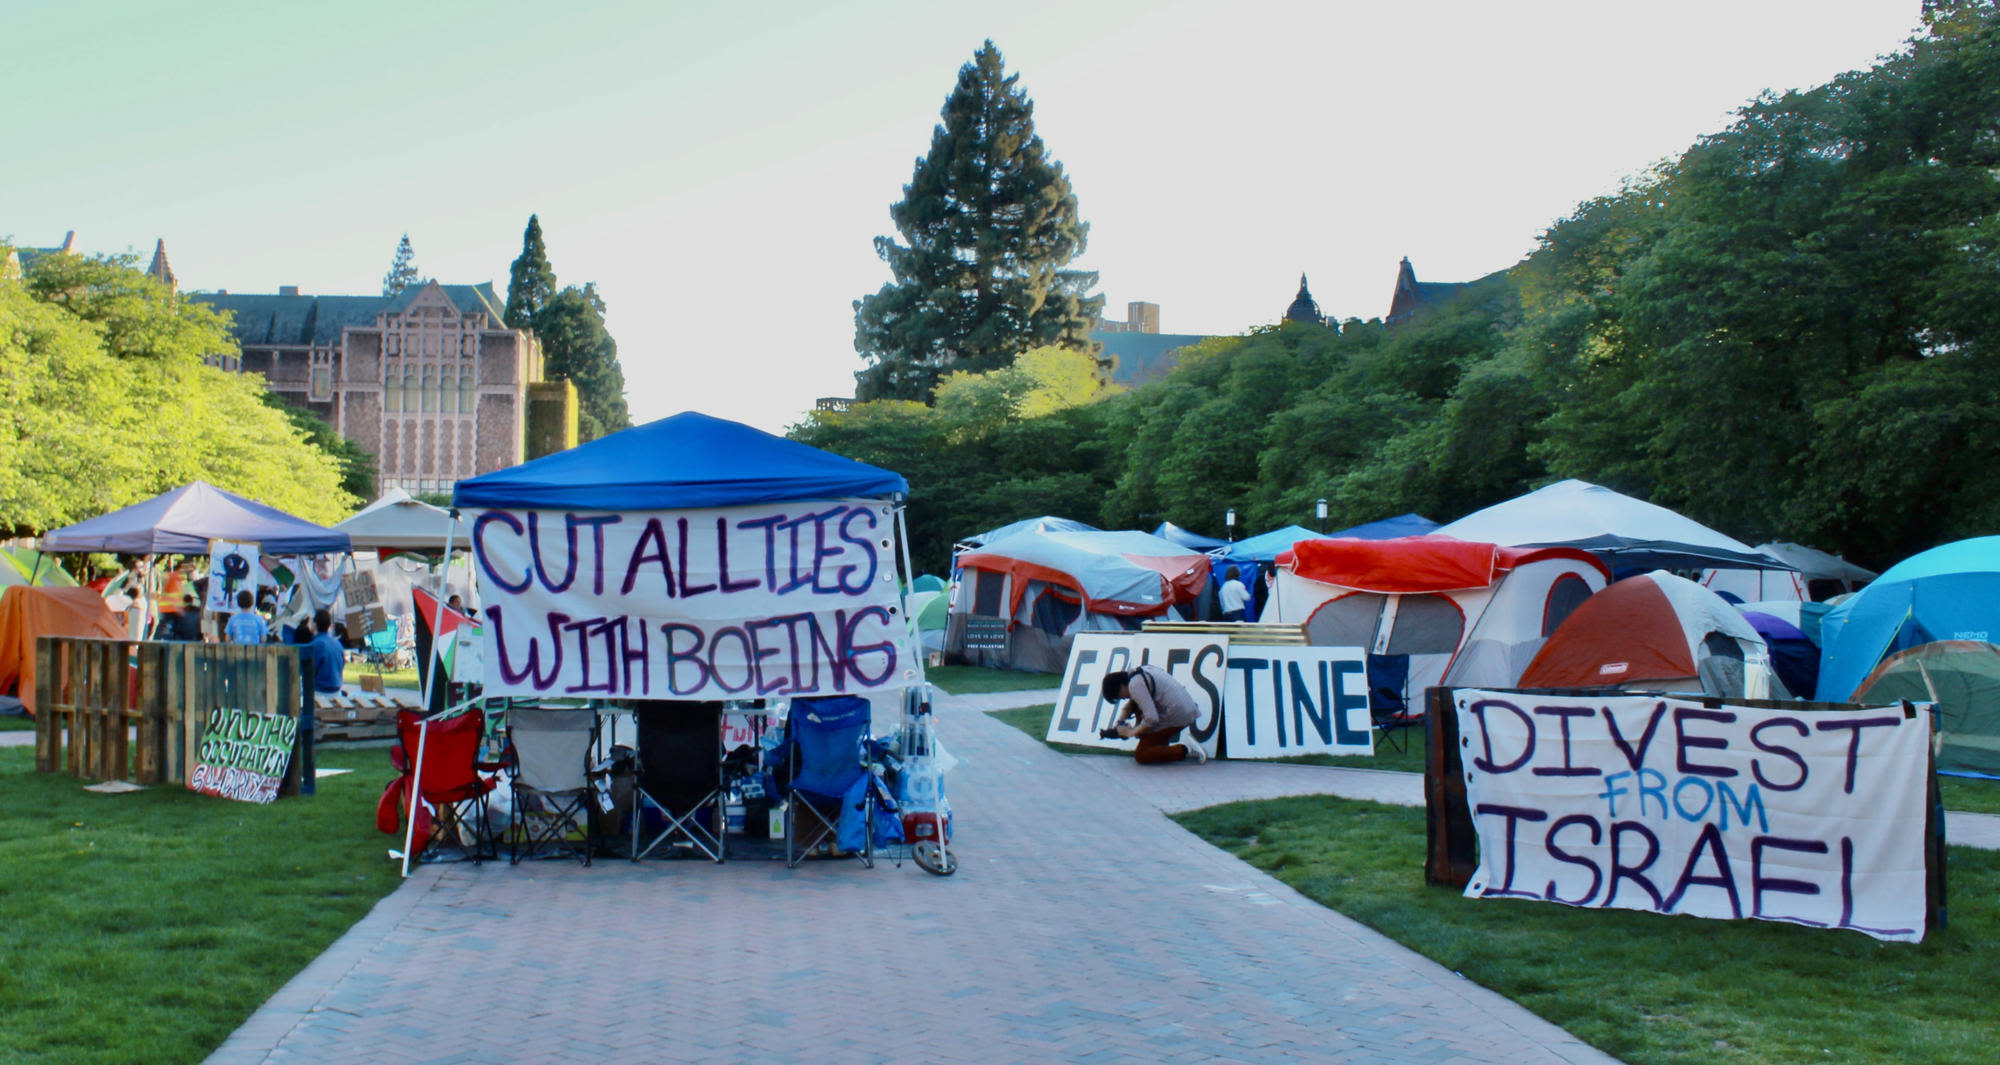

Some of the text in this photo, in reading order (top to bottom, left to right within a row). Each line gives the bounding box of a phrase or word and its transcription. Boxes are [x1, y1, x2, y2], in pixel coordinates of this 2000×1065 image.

[472, 509, 621, 596] CUT
[621, 517, 761, 598] ALL
[738, 506, 878, 595] TIES
[486, 605, 897, 695] WITH BOEING
[1953, 631, 1988, 639] NEMO
[200, 739, 292, 779] OCCUPATION
[1468, 700, 1901, 794] DIVEST
[1599, 768, 1770, 834] FROM
